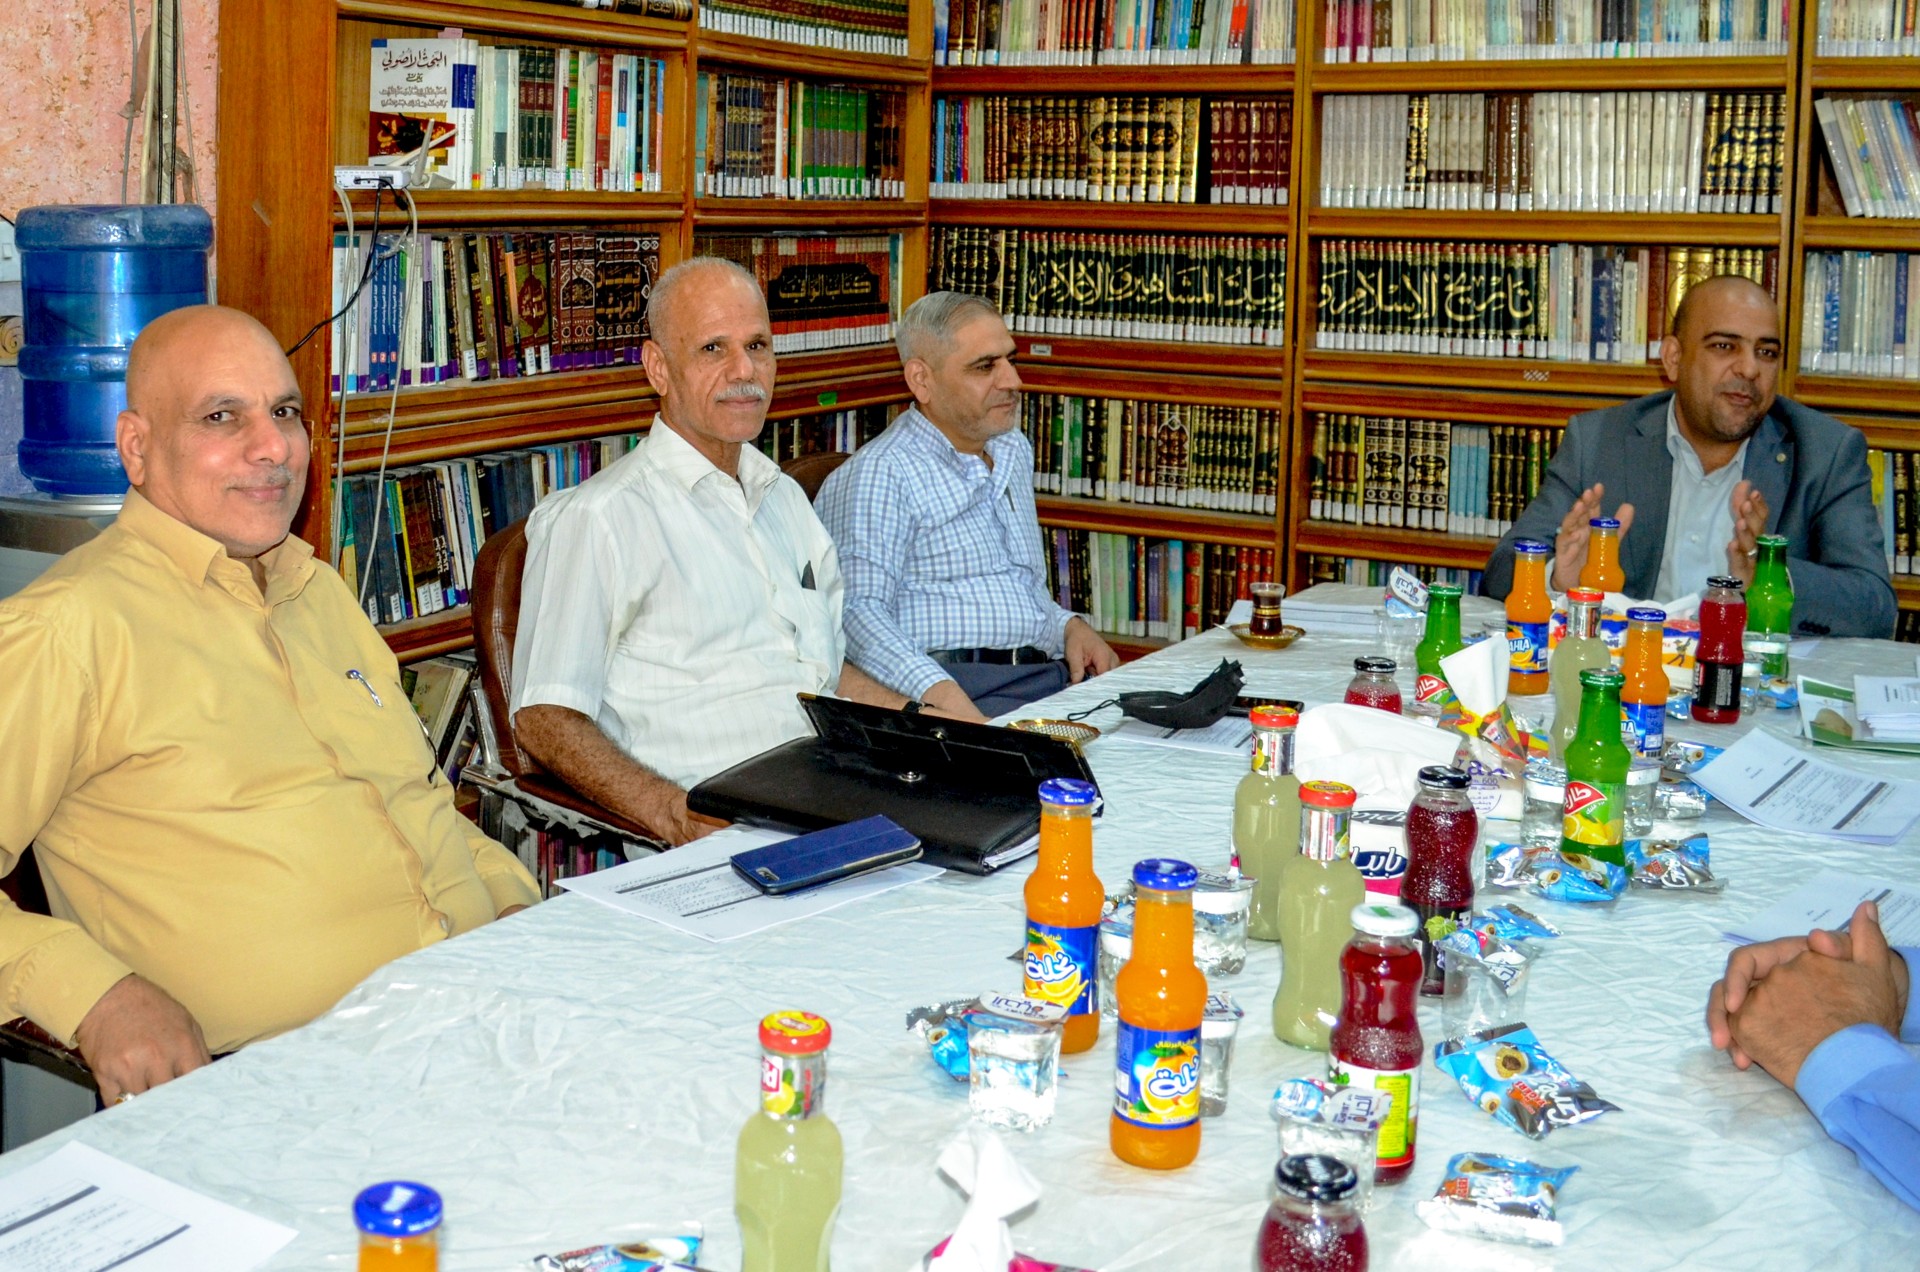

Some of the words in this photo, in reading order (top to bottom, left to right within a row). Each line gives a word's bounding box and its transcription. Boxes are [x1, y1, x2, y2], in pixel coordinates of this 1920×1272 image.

[382, 47, 421, 72] الأصولي
[825, 271, 872, 300] كتاب
[1330, 267, 1439, 320] الإسلام
[1444, 271, 1533, 321] تاريخ
[1025, 951, 1078, 982] نخلة
